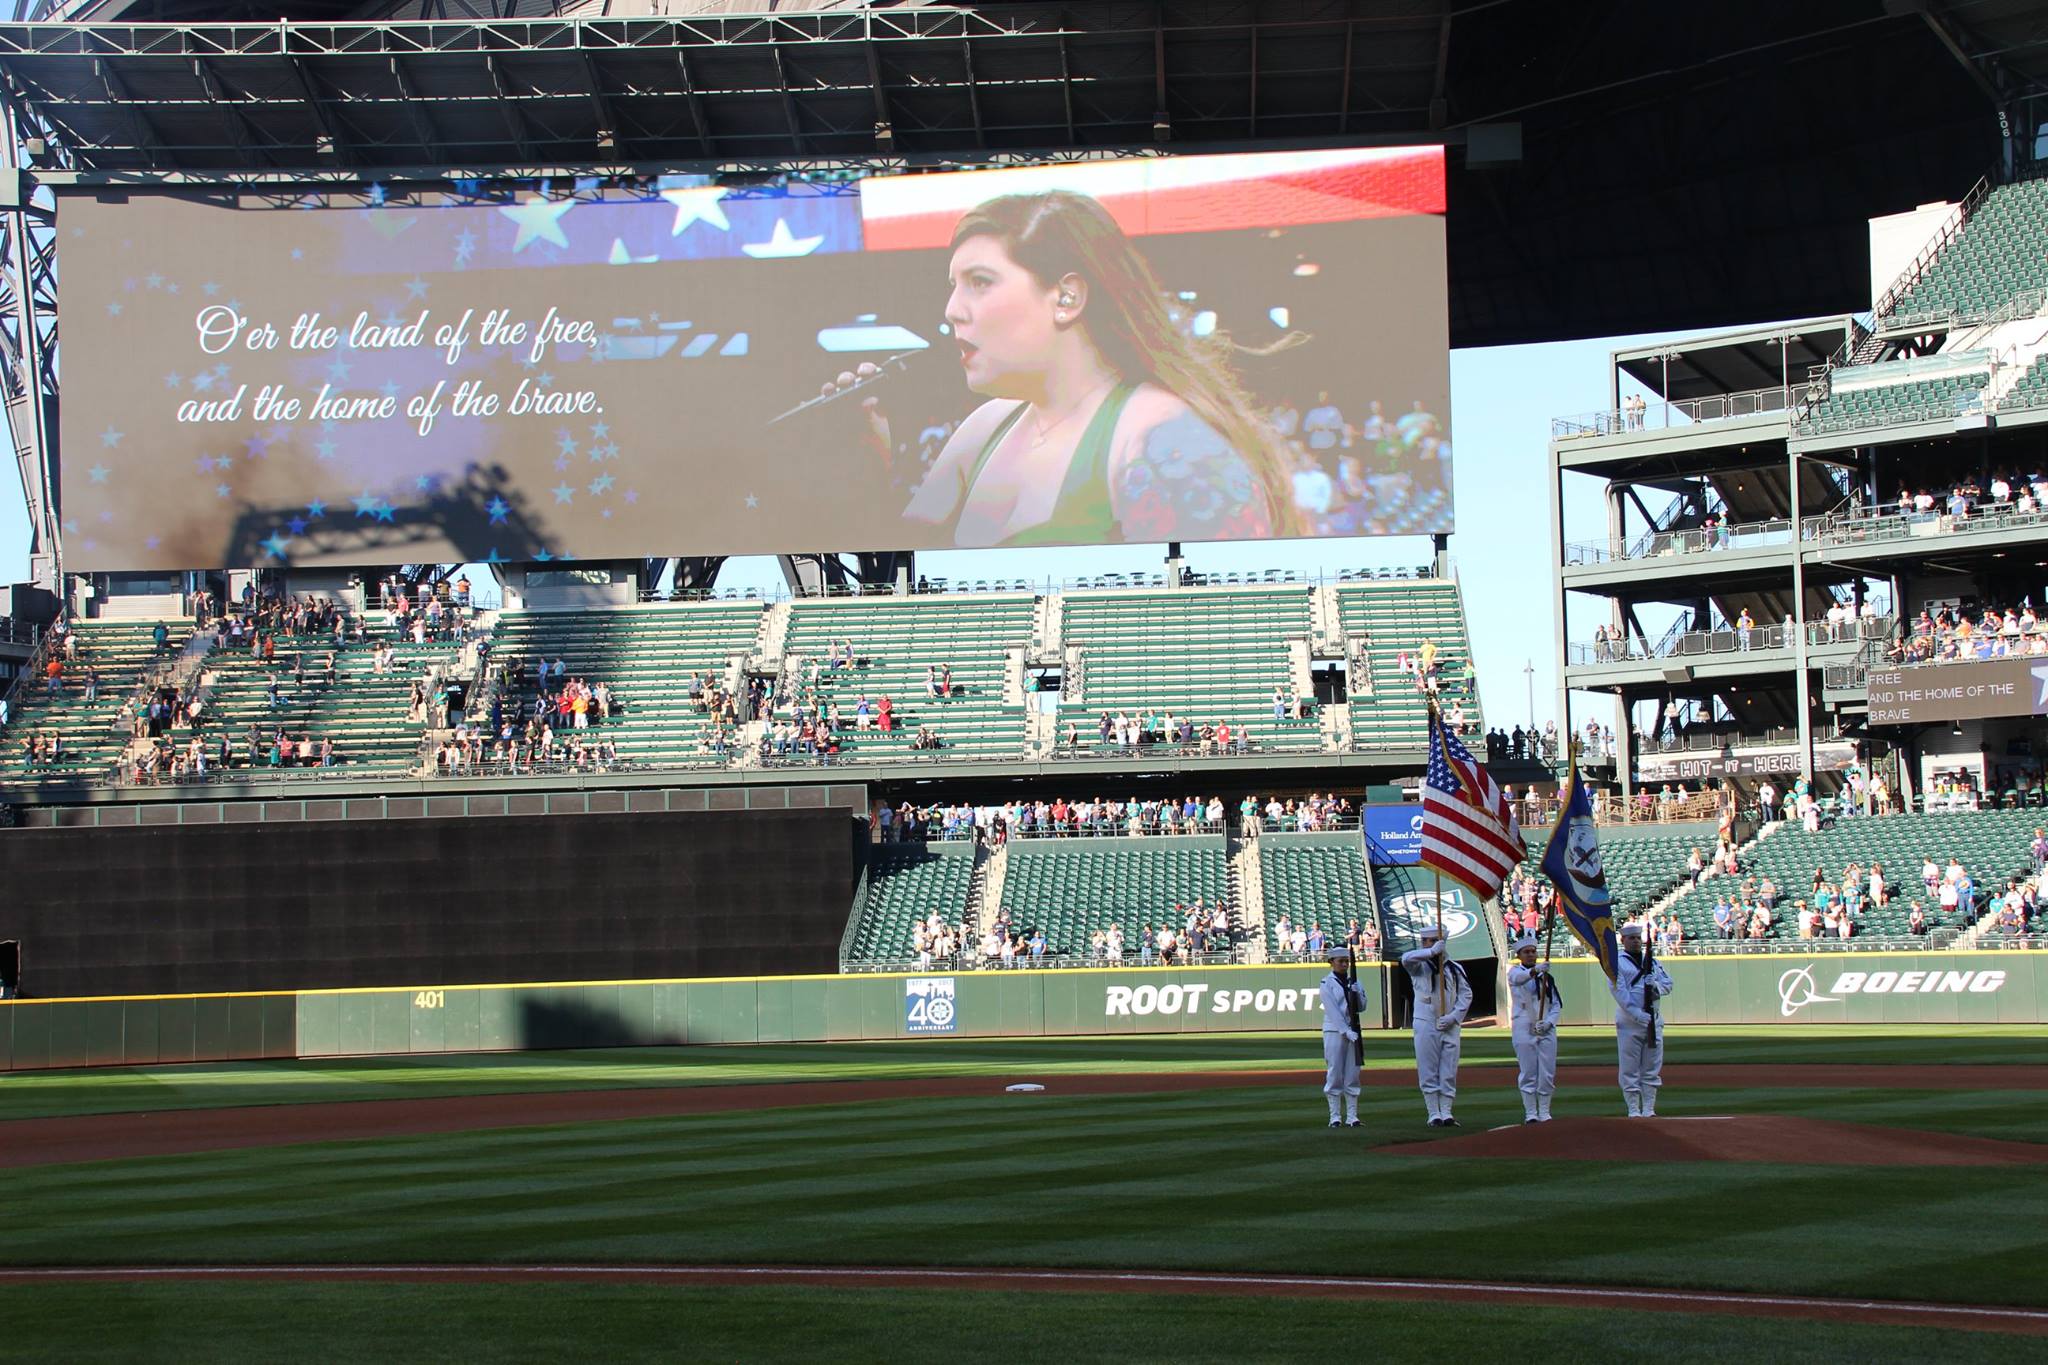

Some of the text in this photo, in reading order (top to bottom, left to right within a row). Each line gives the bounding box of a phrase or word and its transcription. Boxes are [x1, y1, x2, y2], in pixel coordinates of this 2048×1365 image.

[289, 313, 338, 349] the
[348, 309, 428, 349] land
[434, 308, 475, 364] of
[479, 308, 527, 346] the
[534, 306, 598, 363] free,
[176, 378, 604, 437] and the home of the brave.
[1868, 673, 1902, 685] FREE
[1869, 683, 2014, 703] AND THE HOME OF THE
[1870, 709, 1910, 721] BRAVE
[1381, 831, 1409, 840] Holland
[1830, 970, 2006, 993] BOEING
[415, 990, 444, 1009] 401
[1105, 984, 1326, 1015] ROOT SPORT
